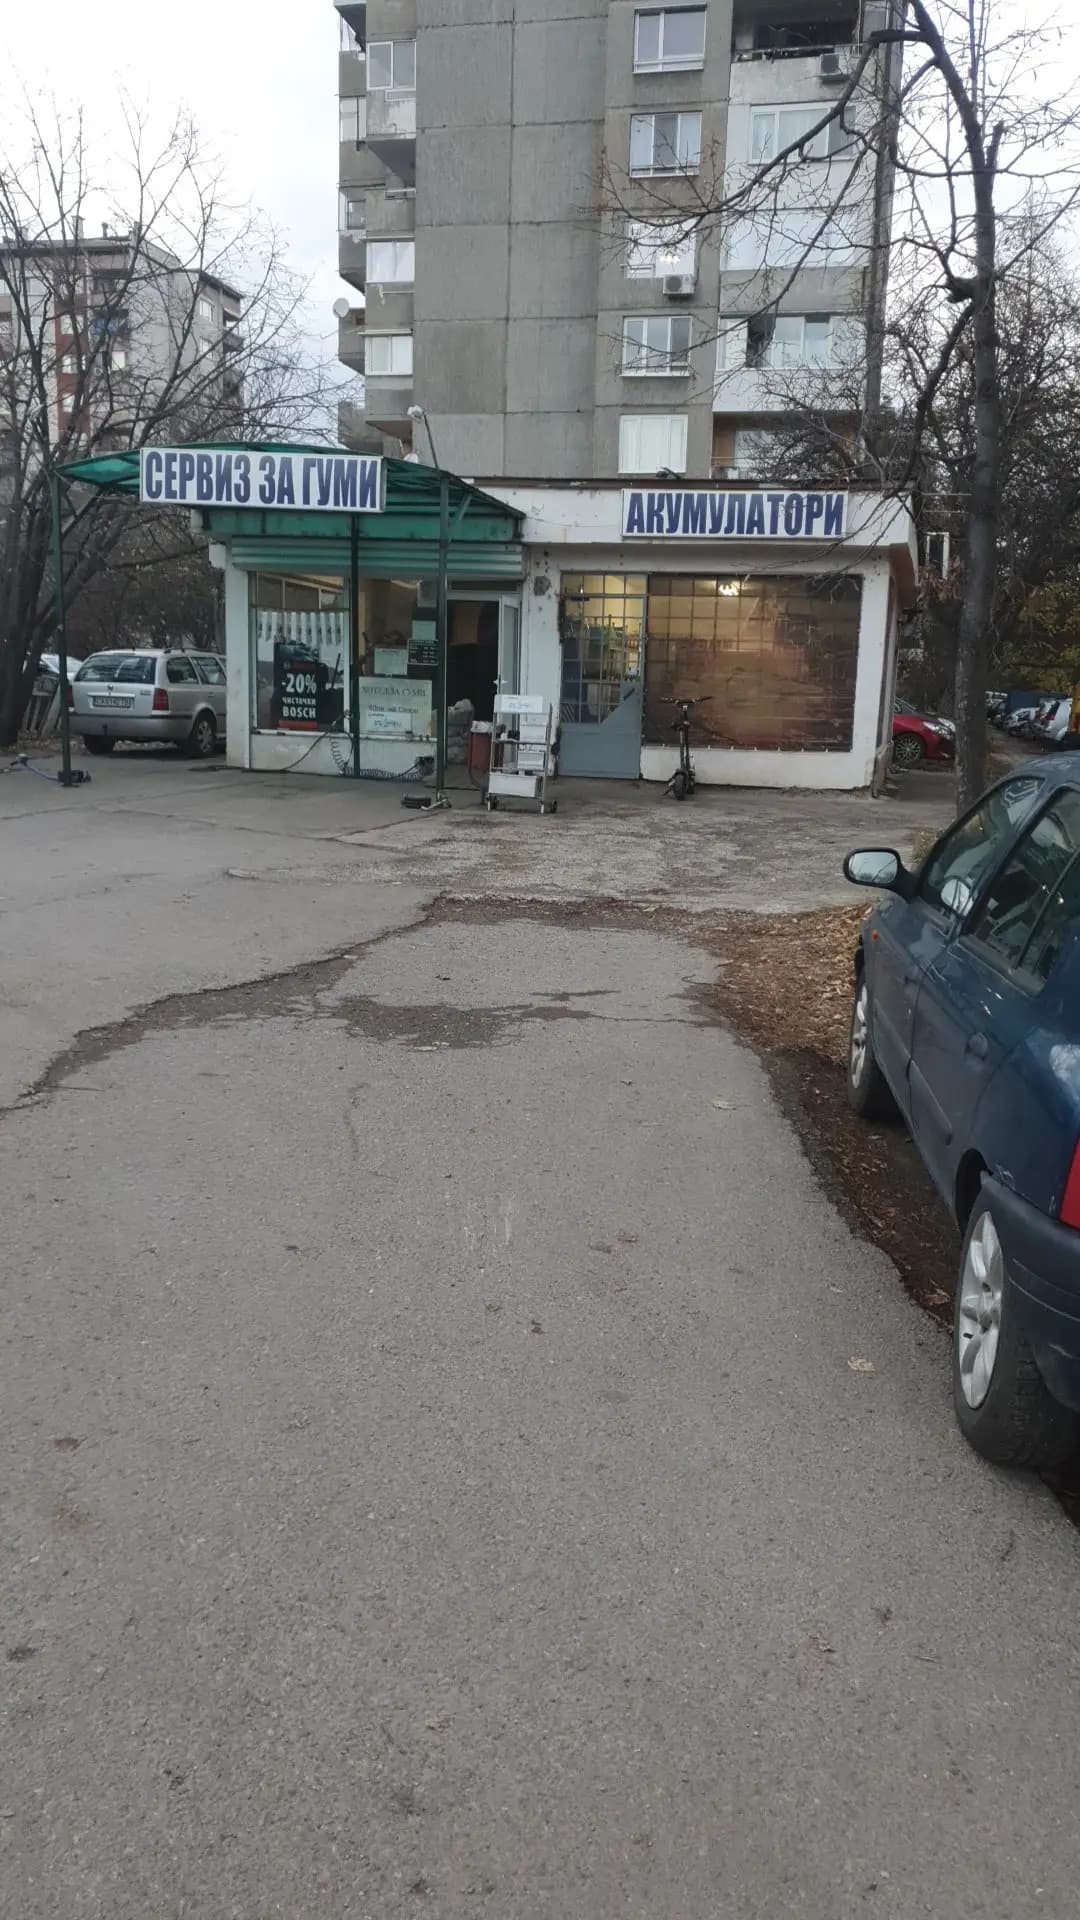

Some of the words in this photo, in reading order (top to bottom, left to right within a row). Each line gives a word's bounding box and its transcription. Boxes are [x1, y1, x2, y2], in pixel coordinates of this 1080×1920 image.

[146, 451, 250, 503] СЕРВИЗ
[259, 455, 295, 505] ЗА
[303, 457, 378, 509] ГУМИ
[626, 493, 844, 535] АКУМУЛАТОРИ
[281, 673, 317, 694] -20%
[282, 706, 316, 718] BOSCH
